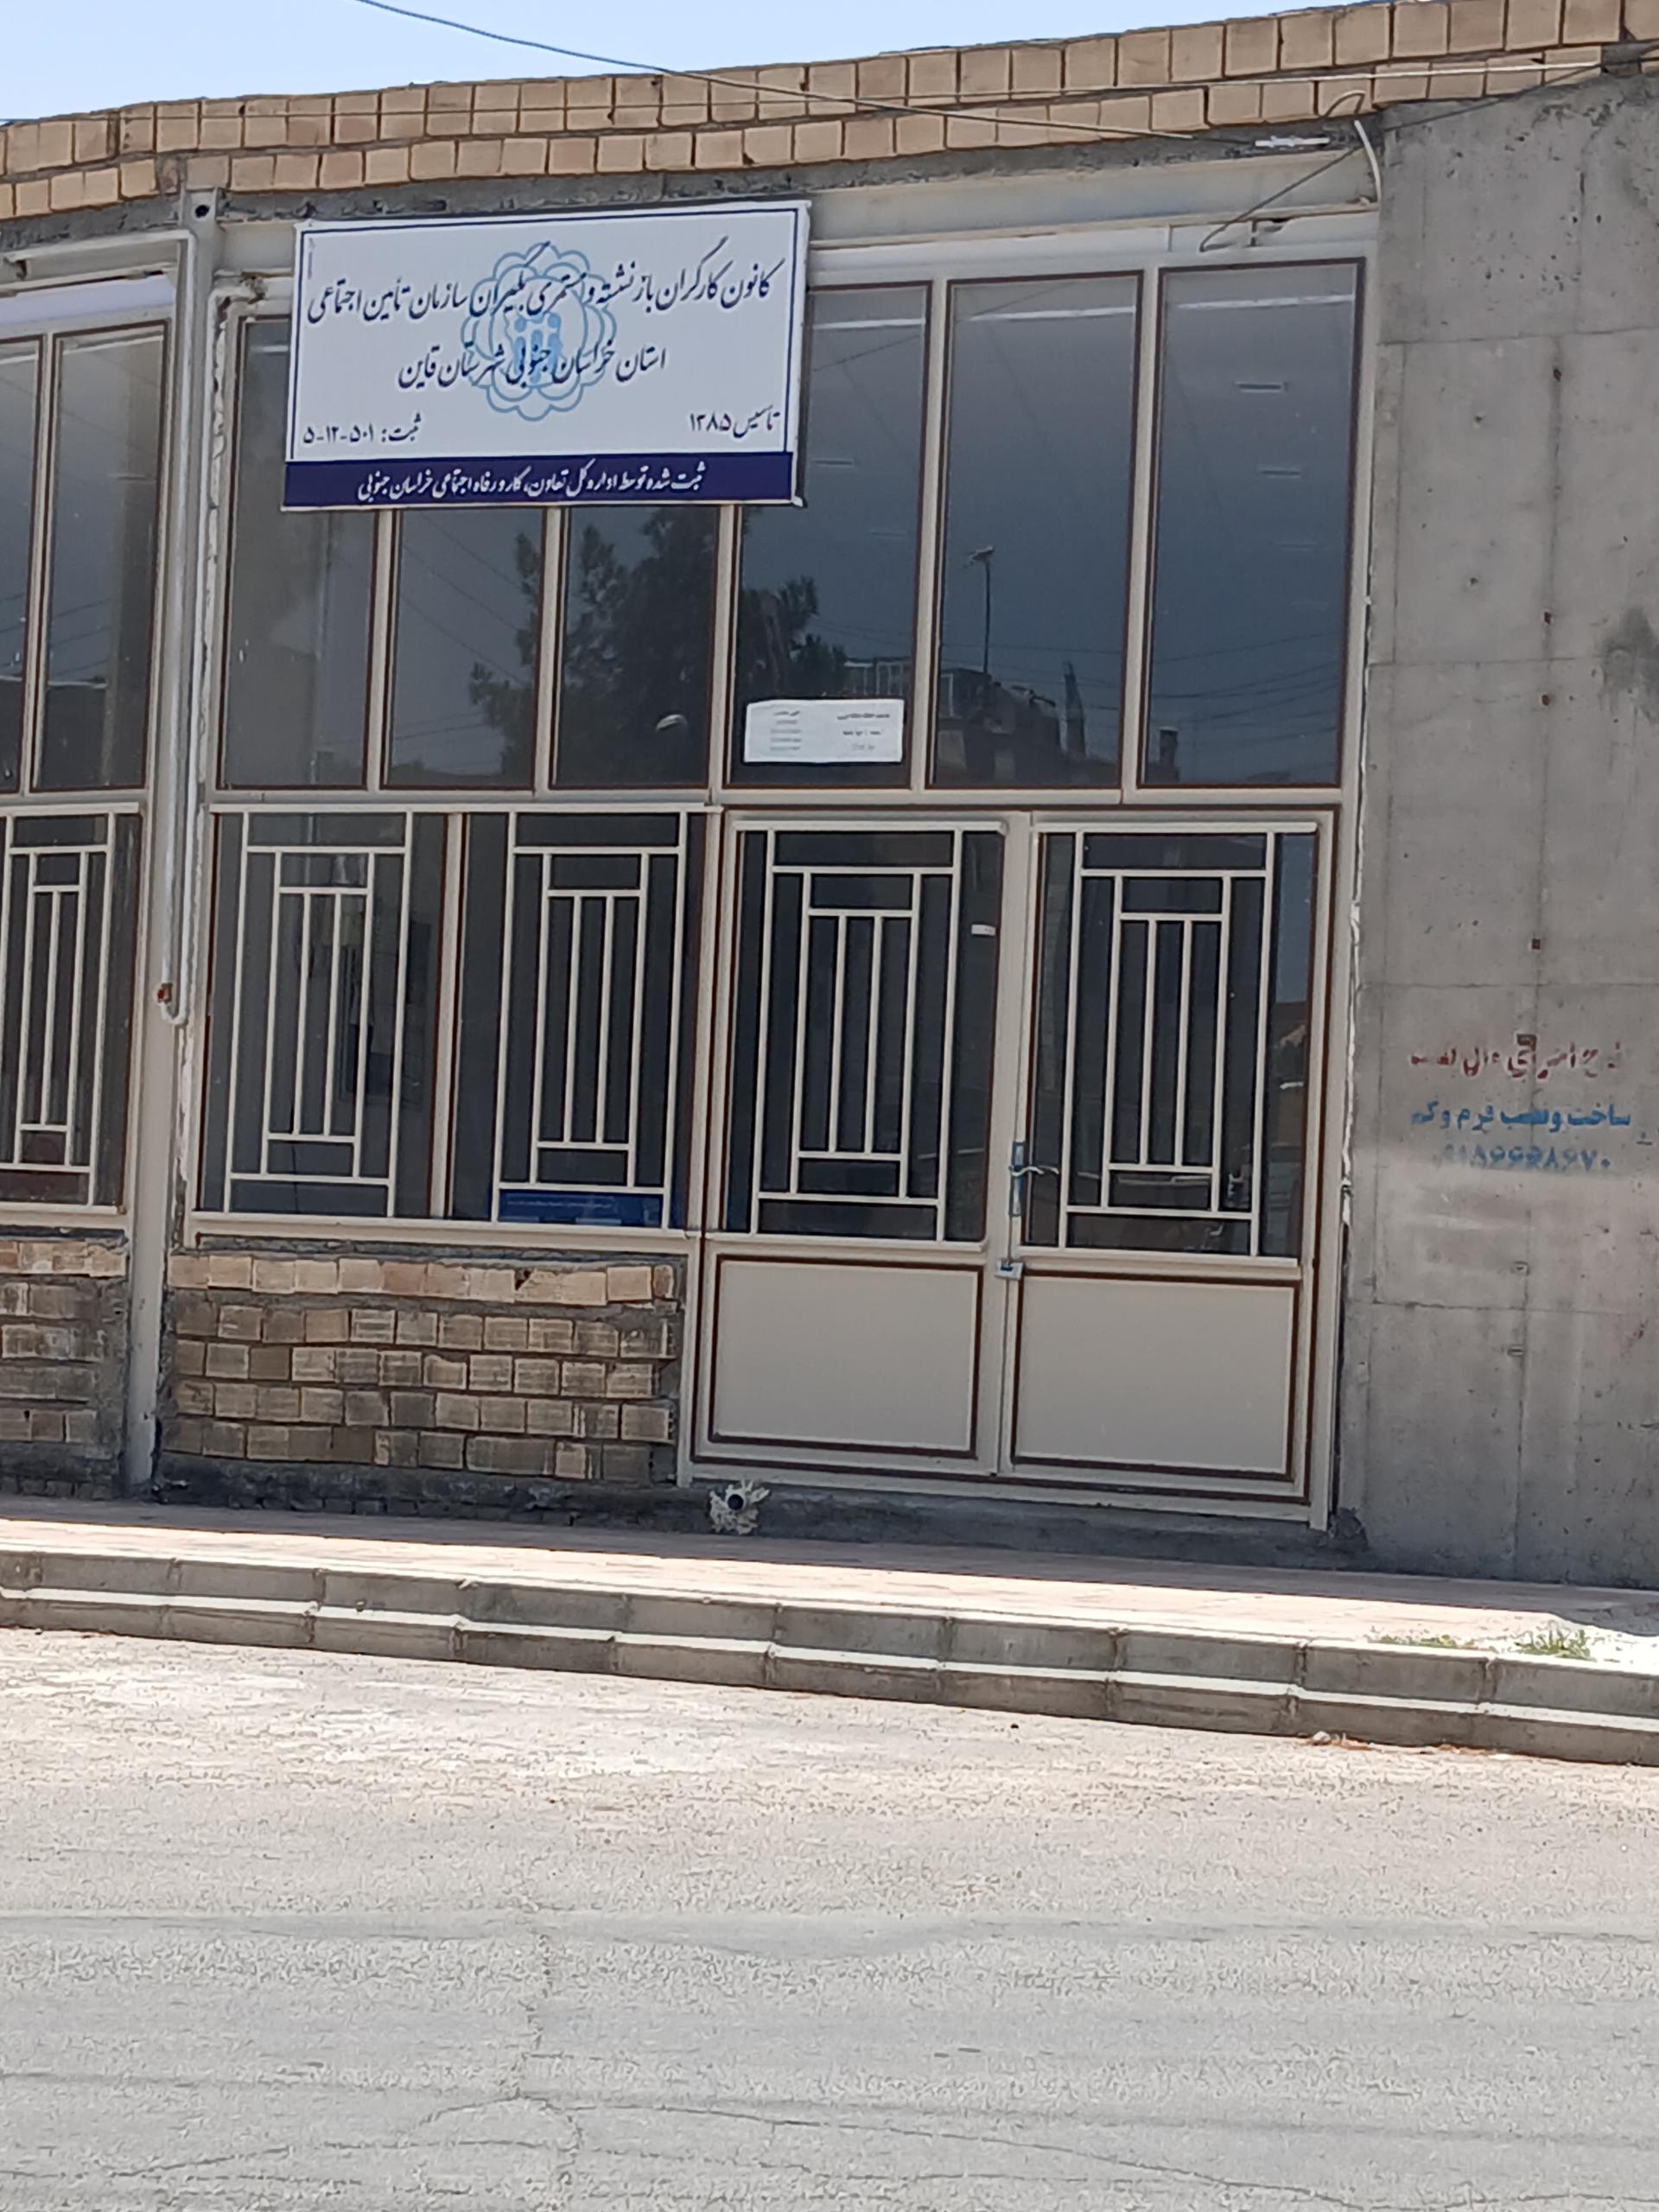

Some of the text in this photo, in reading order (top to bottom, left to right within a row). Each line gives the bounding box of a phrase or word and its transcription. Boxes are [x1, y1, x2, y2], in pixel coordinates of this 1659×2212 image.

[721, 258, 785, 308] کانون
[308, 278, 362, 323] اجتماعی
[409, 281, 468, 320] سازمان
[398, 340, 667, 388] استان خراسان جنوبی شهرستان قاین
[358, 470, 391, 503] جنوبی
[389, 468, 434, 500] خراسان
[432, 467, 473, 498] اجتماعی
[566, 458, 596, 497] کل
[619, 465, 649, 490] توسط
[646, 467, 671, 490] شده
[671, 461, 706, 491] ثبت
